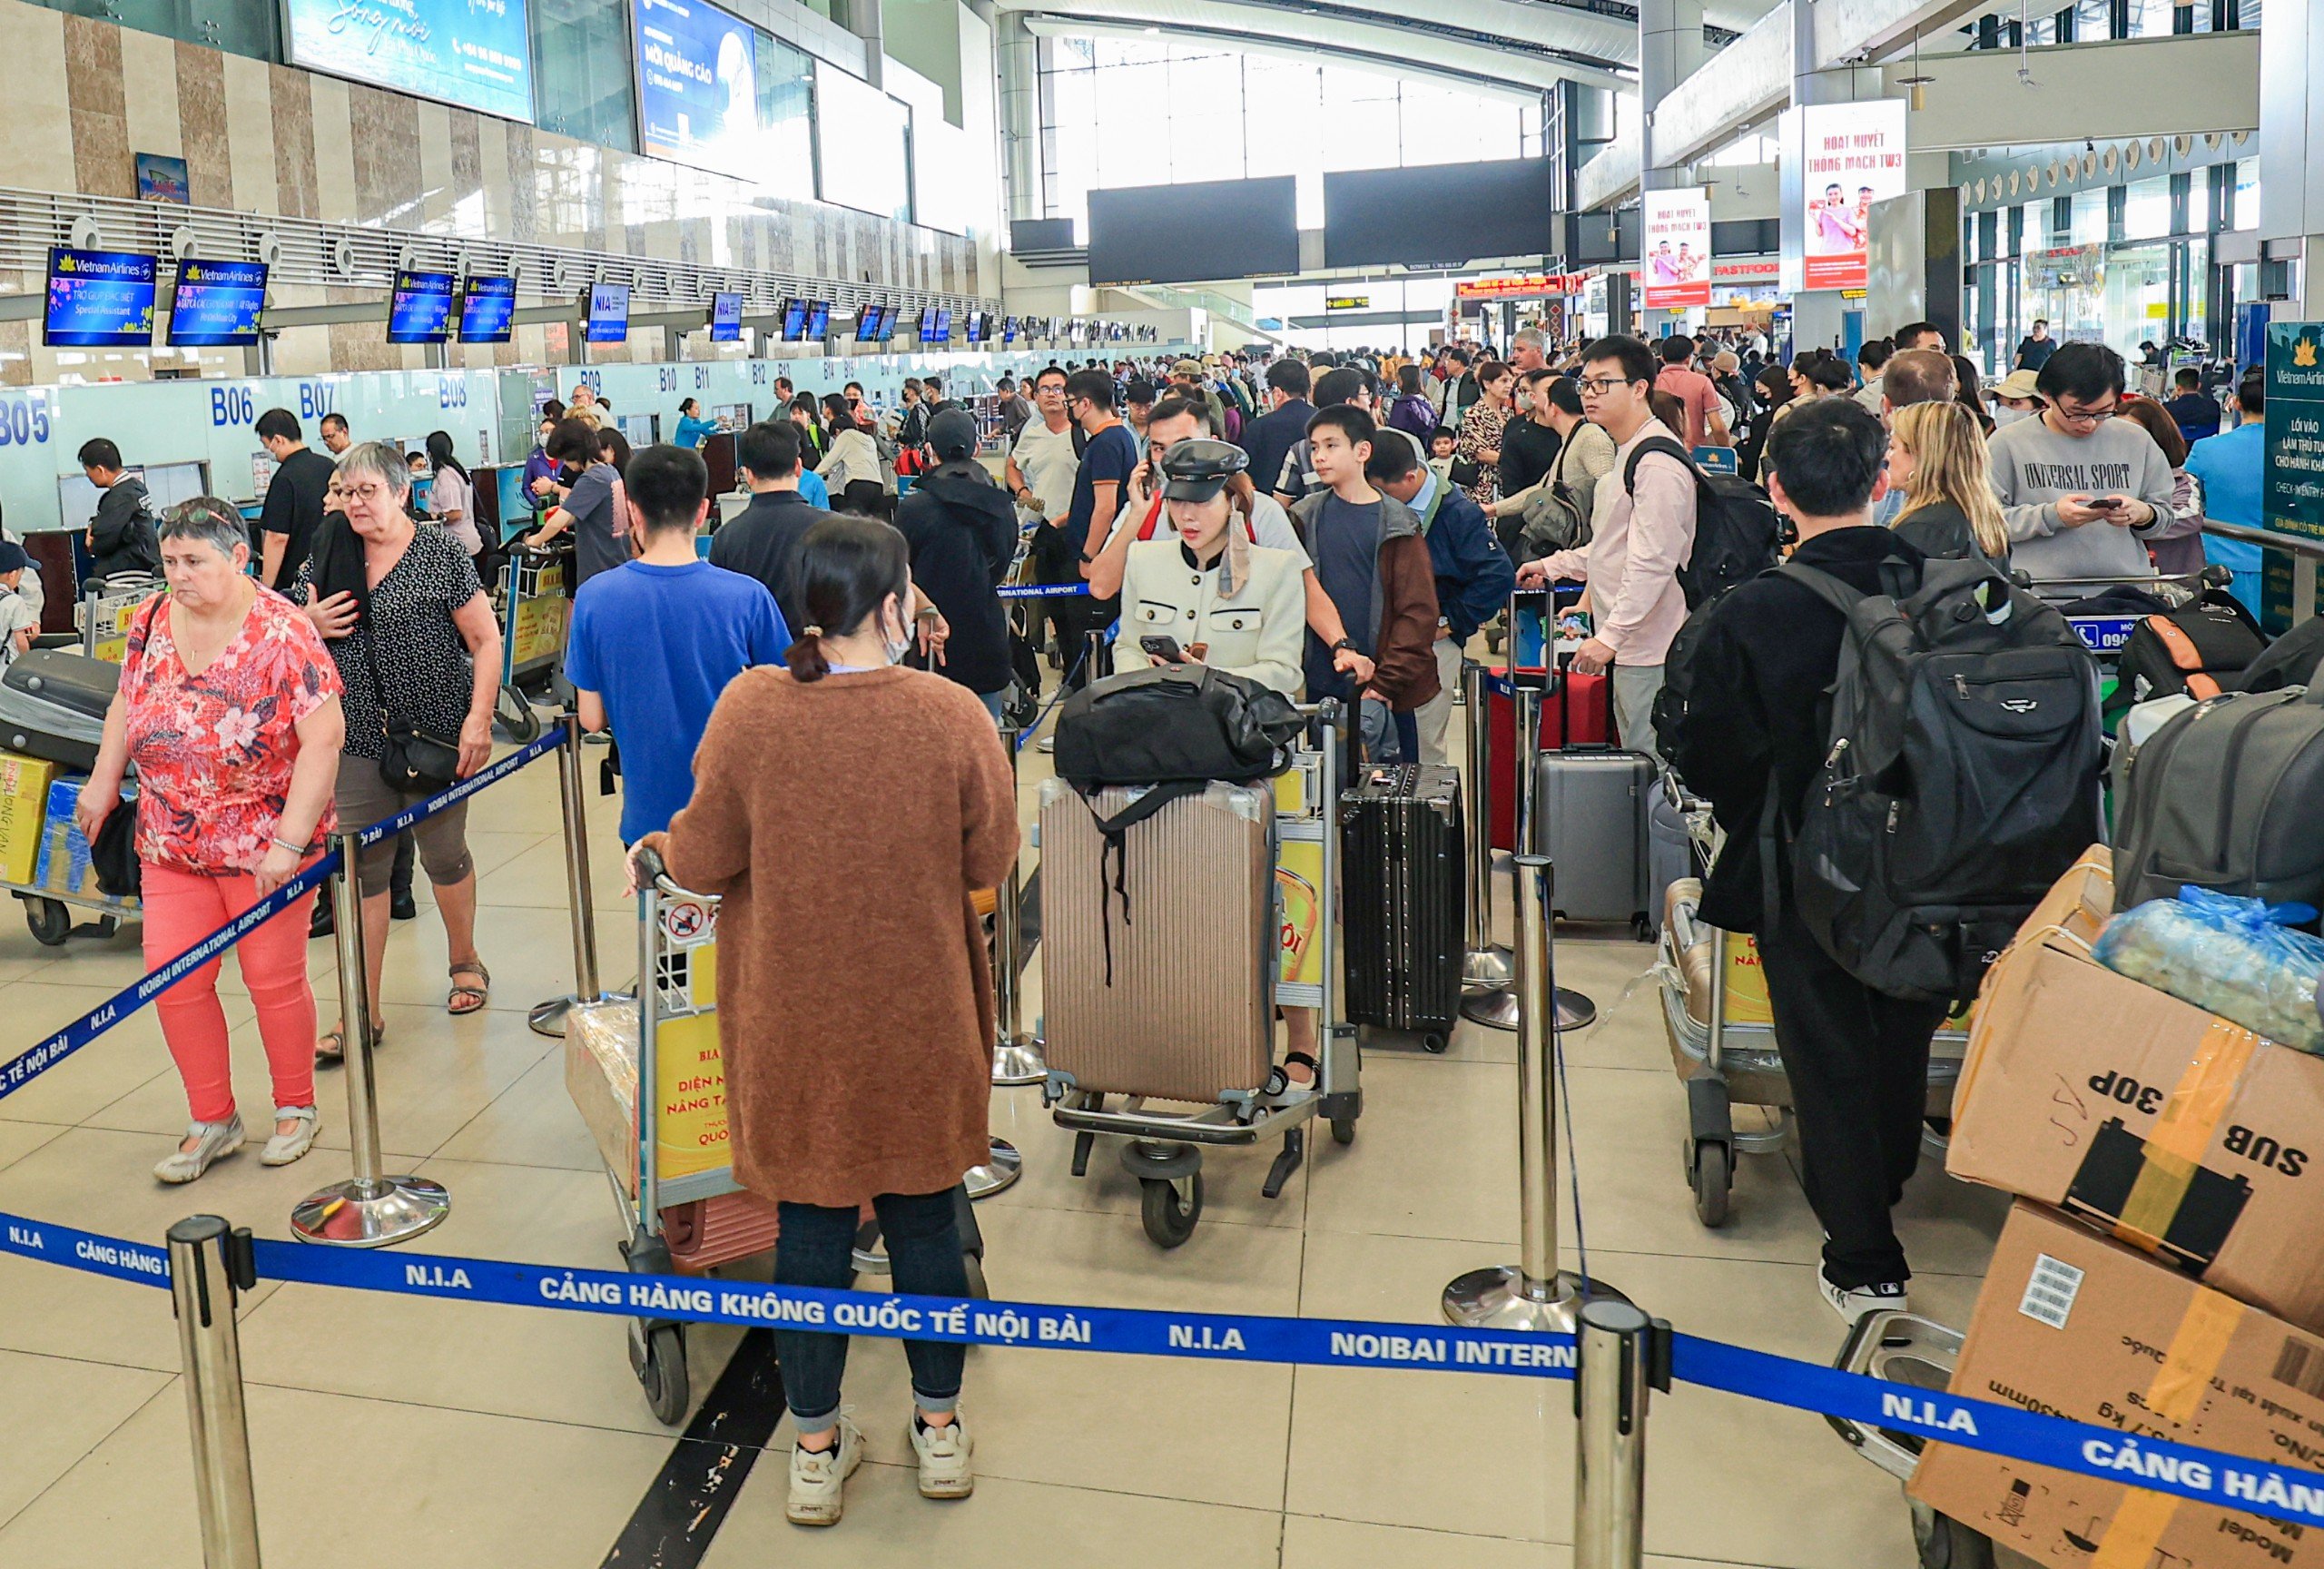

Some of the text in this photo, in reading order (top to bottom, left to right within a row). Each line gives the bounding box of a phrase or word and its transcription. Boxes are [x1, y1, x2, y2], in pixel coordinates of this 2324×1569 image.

[1880, 153, 1902, 169] TW3
[75, 304, 131, 316] Special Assistant
[595, 295, 611, 311] NIA
[717, 302, 730, 317] NIA
[660, 368, 676, 392] B10
[695, 366, 710, 390] B11
[753, 363, 766, 385] B12
[300, 382, 334, 419] B07
[438, 377, 467, 409] B08
[211, 386, 253, 426] B06
[2304, 419, 2319, 433] VÀO
[2282, 437, 2297, 450] LÀM
[2275, 455, 2289, 468] CHO
[2290, 455, 2309, 470] HÀNH
[2024, 463, 2130, 490] UNIVERSAL SPORT
[1044, 586, 1078, 595] AIRPORT
[397, 813, 414, 829] N.I.A
[448, 770, 496, 802] INTERNATIONAL
[495, 756, 519, 776] AIRPORT
[7, 1058, 25, 1084] TẾ
[26, 1045, 48, 1072] NỘI
[49, 1035, 68, 1062] BÀI
[91, 1005, 116, 1031] N.I.A
[138, 965, 171, 1000] NOIBAI
[172, 925, 237, 977] INTERNATIONAL
[238, 902, 271, 934] AIRPORT
[286, 881, 304, 901] N.I.A
[699, 1049, 720, 1061] BIA
[678, 1075, 712, 1092] DIỆN
[2089, 1070, 2309, 1178] SUB 30P
[9, 1226, 162, 1277] N.I.A CẢNG HÀNG
[405, 1264, 472, 1290] N.I.A
[539, 1273, 621, 1305] CẢNG
[629, 1281, 712, 1314] HÀNG
[721, 1291, 825, 1325] KHÔNG
[833, 1298, 921, 1332] QUỐC
[929, 1303, 967, 1335] TẾ
[975, 1315, 1029, 1344] NỘI
[1039, 1312, 1091, 1344] BÀI
[1169, 1325, 1246, 1352] N.I.A
[1331, 1331, 1446, 1364] NOIBAI
[2097, 1402, 2125, 1428] kg
[1882, 1393, 1979, 1436] N.I.A
[2083, 1438, 2212, 1492] CẢNG
[2219, 1517, 2295, 1565] Model
